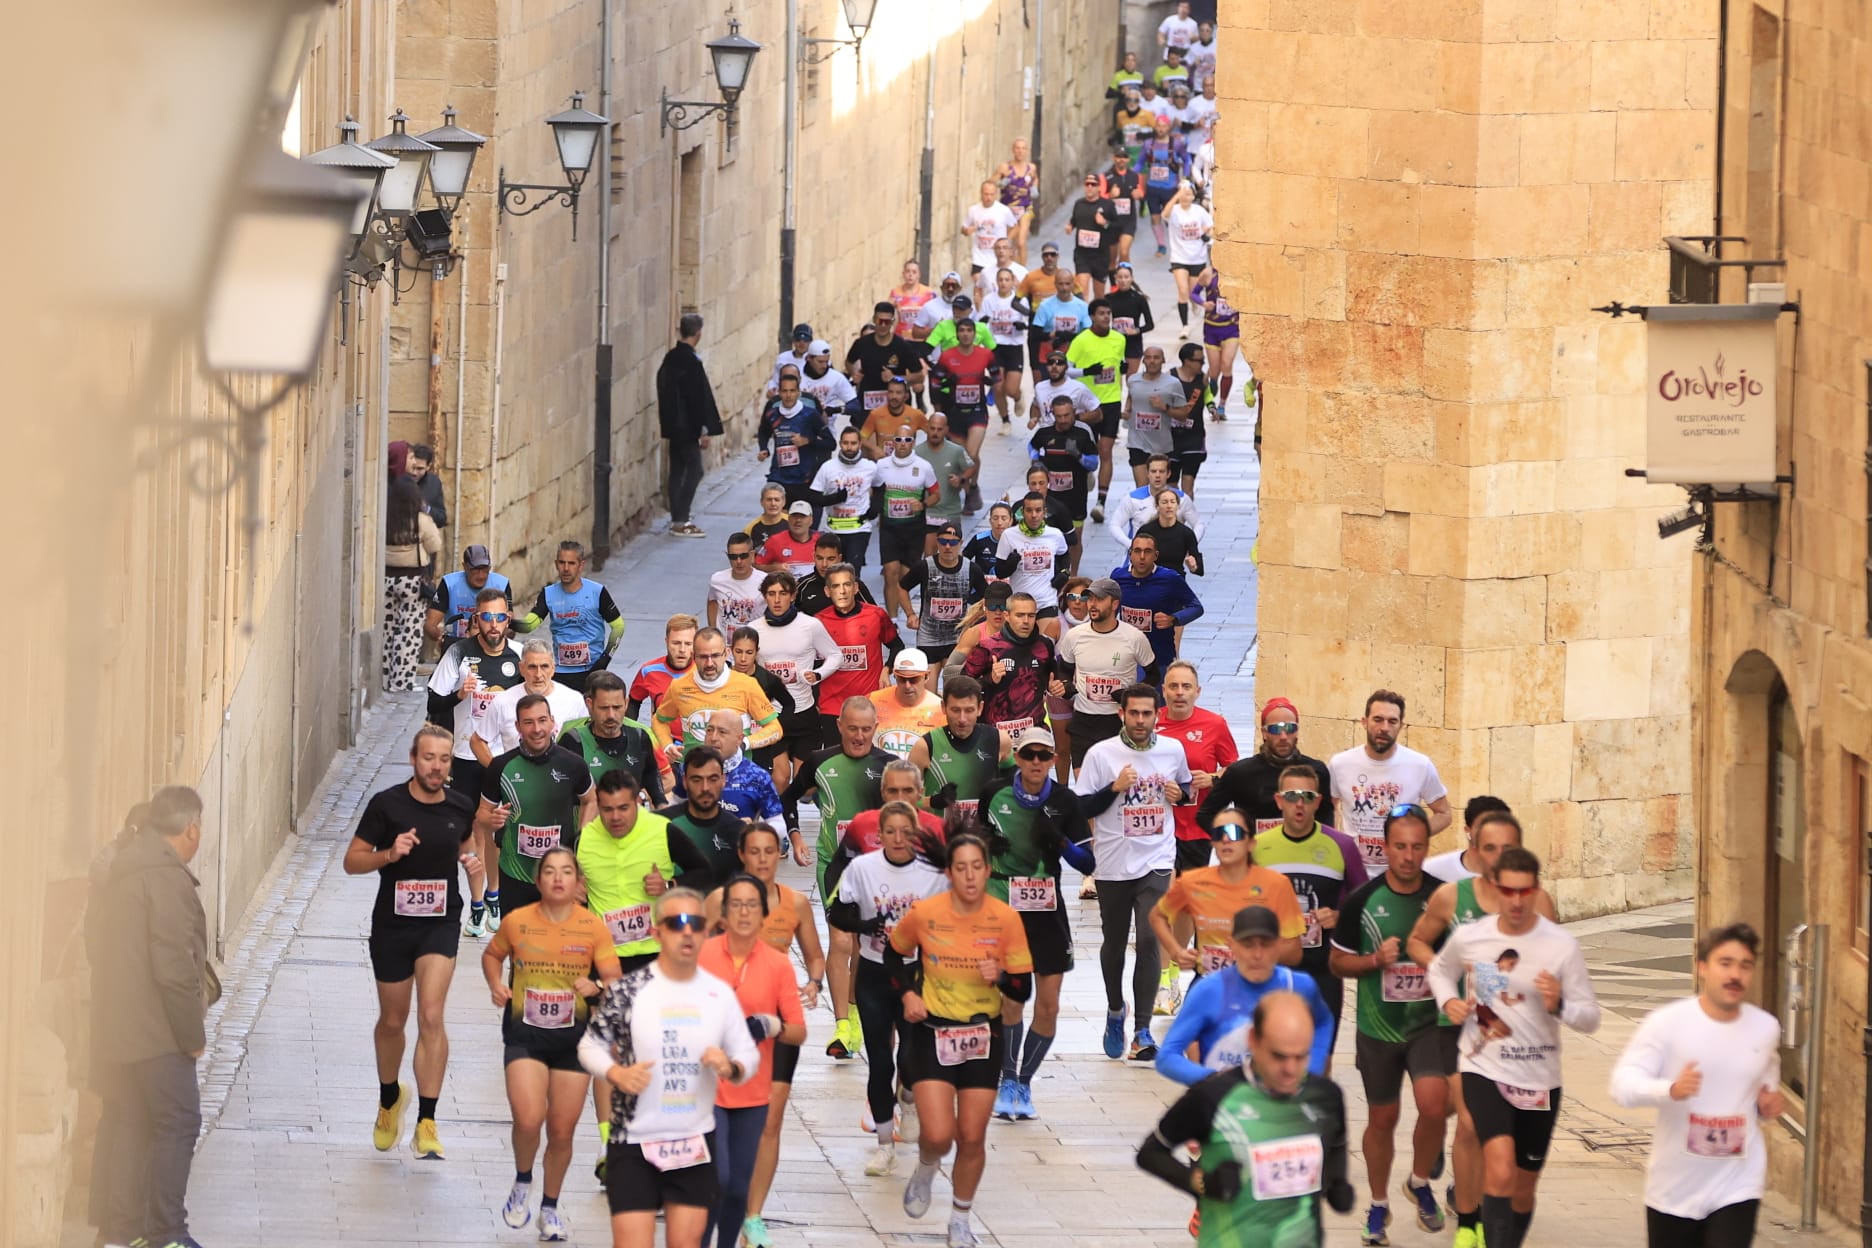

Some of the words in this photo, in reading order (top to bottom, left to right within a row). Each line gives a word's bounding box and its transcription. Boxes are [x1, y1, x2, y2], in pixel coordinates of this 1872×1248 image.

[1676, 414, 1747, 423] RESTAURANTE
[1682, 428, 1740, 437] GASTROBAR
[1032, 556, 1044, 565] 23
[937, 605, 956, 613] 597
[1127, 614, 1145, 624] 299
[564, 650, 582, 659] 489
[844, 653, 859, 663] 90
[1092, 684, 1113, 695] 317
[1124, 808, 1164, 816] bedunia
[1132, 815, 1156, 828] 311
[527, 837, 552, 848] 380
[406, 892, 435, 905] 238
[1020, 888, 1046, 900] 532
[617, 915, 645, 933] 148
[1395, 975, 1424, 989] 277
[540, 1003, 560, 1016] 88
[950, 1036, 979, 1053] 160
[662, 1063, 700, 1075] CROSS
[1706, 1129, 1728, 1143] 41
